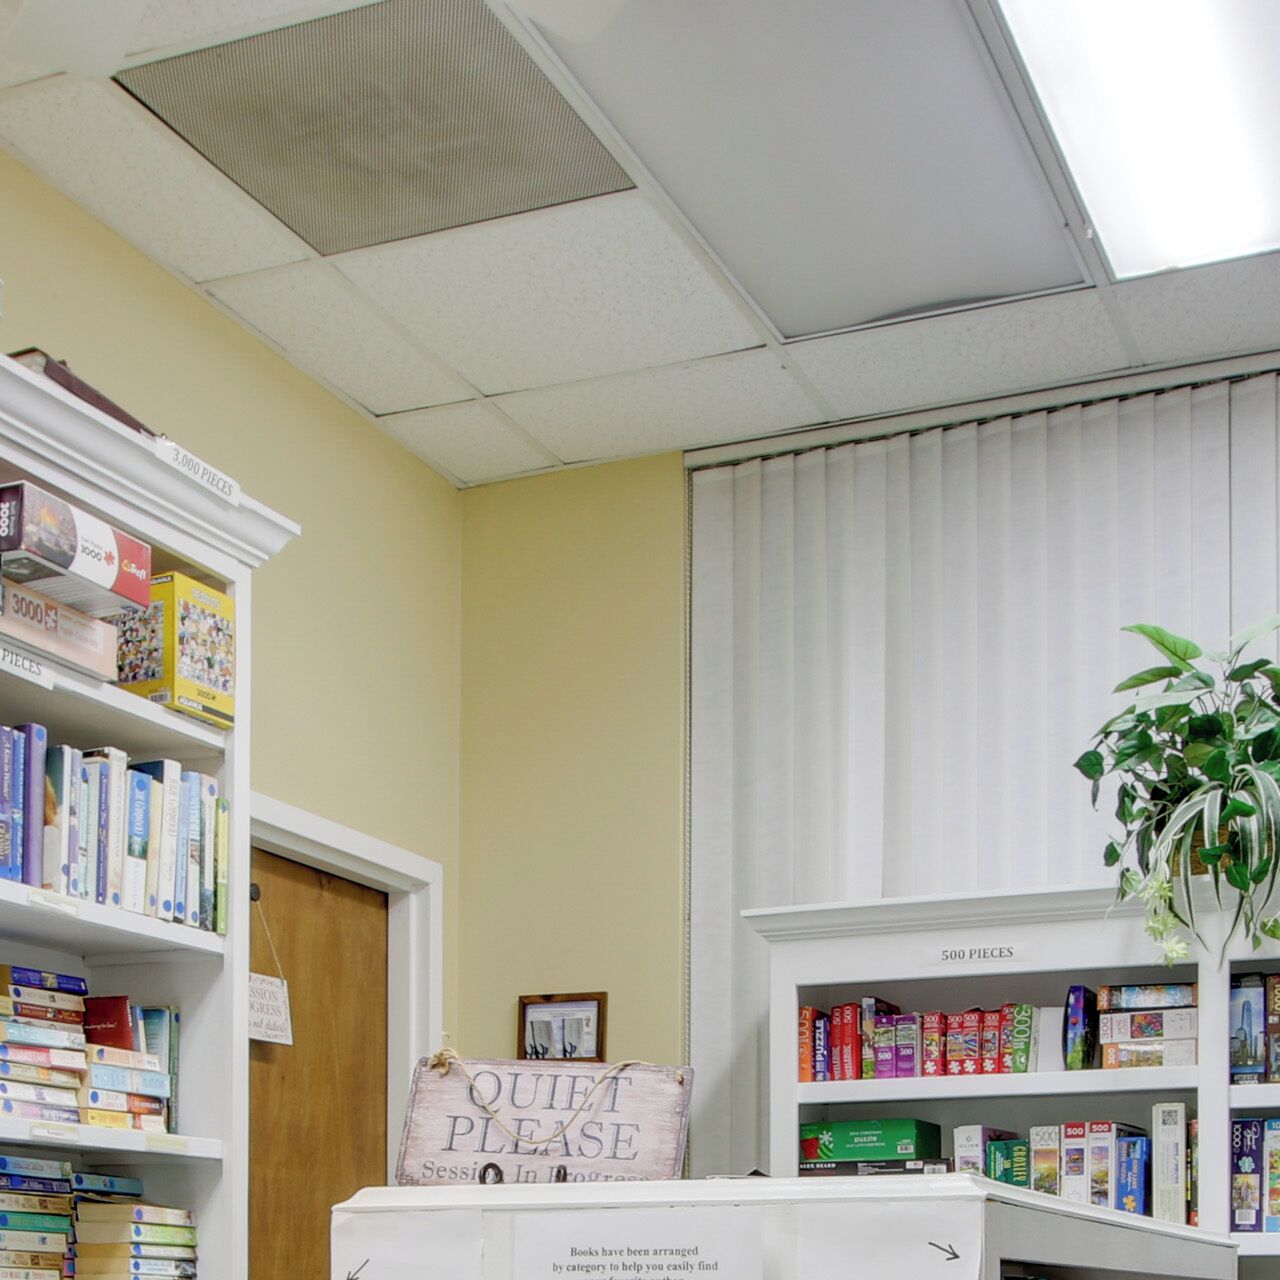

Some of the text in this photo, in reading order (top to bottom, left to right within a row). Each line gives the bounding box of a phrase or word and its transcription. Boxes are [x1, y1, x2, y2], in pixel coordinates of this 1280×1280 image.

[172, 447, 235, 496] 3,000 PIECES
[81, 543, 102, 562] 3000
[11, 594, 44, 624] 3000
[942, 946, 1014, 961] 500 PIECES
[833, 1009, 841, 1025] 500
[843, 1007, 852, 1023] 500
[948, 1015, 962, 1023] 500
[963, 1014, 978, 1022] 500
[984, 1014, 999, 1022] 500
[1101, 1017, 1109, 1039] 300
[878, 1052, 892, 1060] 500
[467, 1071, 632, 1113] QUIET
[1067, 1127, 1083, 1138] 500
[1092, 1123, 1108, 1133] 500
[441, 1115, 641, 1161] PLEASE
[517, 1165, 538, 1182] In
[570, 1246, 698, 1257] Books have been arranged
[552, 1261, 718, 1274] by category to help you easily find
